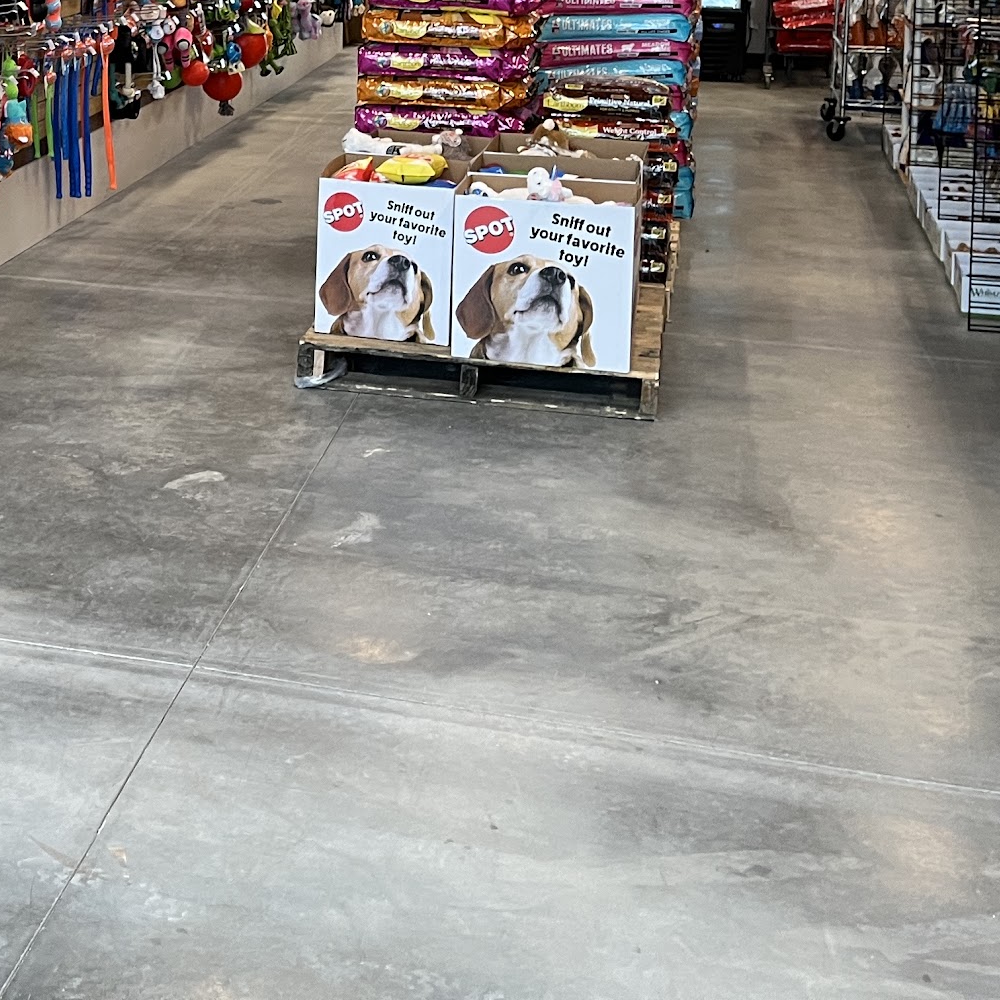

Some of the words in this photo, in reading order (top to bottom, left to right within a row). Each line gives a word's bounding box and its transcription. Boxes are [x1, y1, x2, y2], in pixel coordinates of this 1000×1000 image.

[562, 18, 613, 31] ULTIMATES
[562, 43, 614, 57] ULTIMATES
[602, 126, 629, 136] Weight
[629, 127, 657, 136] Control
[387, 200, 414, 215] Sniff
[414, 209, 435, 221] out
[369, 211, 396, 225] your
[398, 217, 447, 238] favorite
[551, 213, 585, 231] Sniff
[585, 223, 612, 238] out
[392, 230, 417, 245] toy!
[529, 226, 564, 244] your
[566, 233, 626, 259] favorite
[558, 249, 590, 268] toy!
